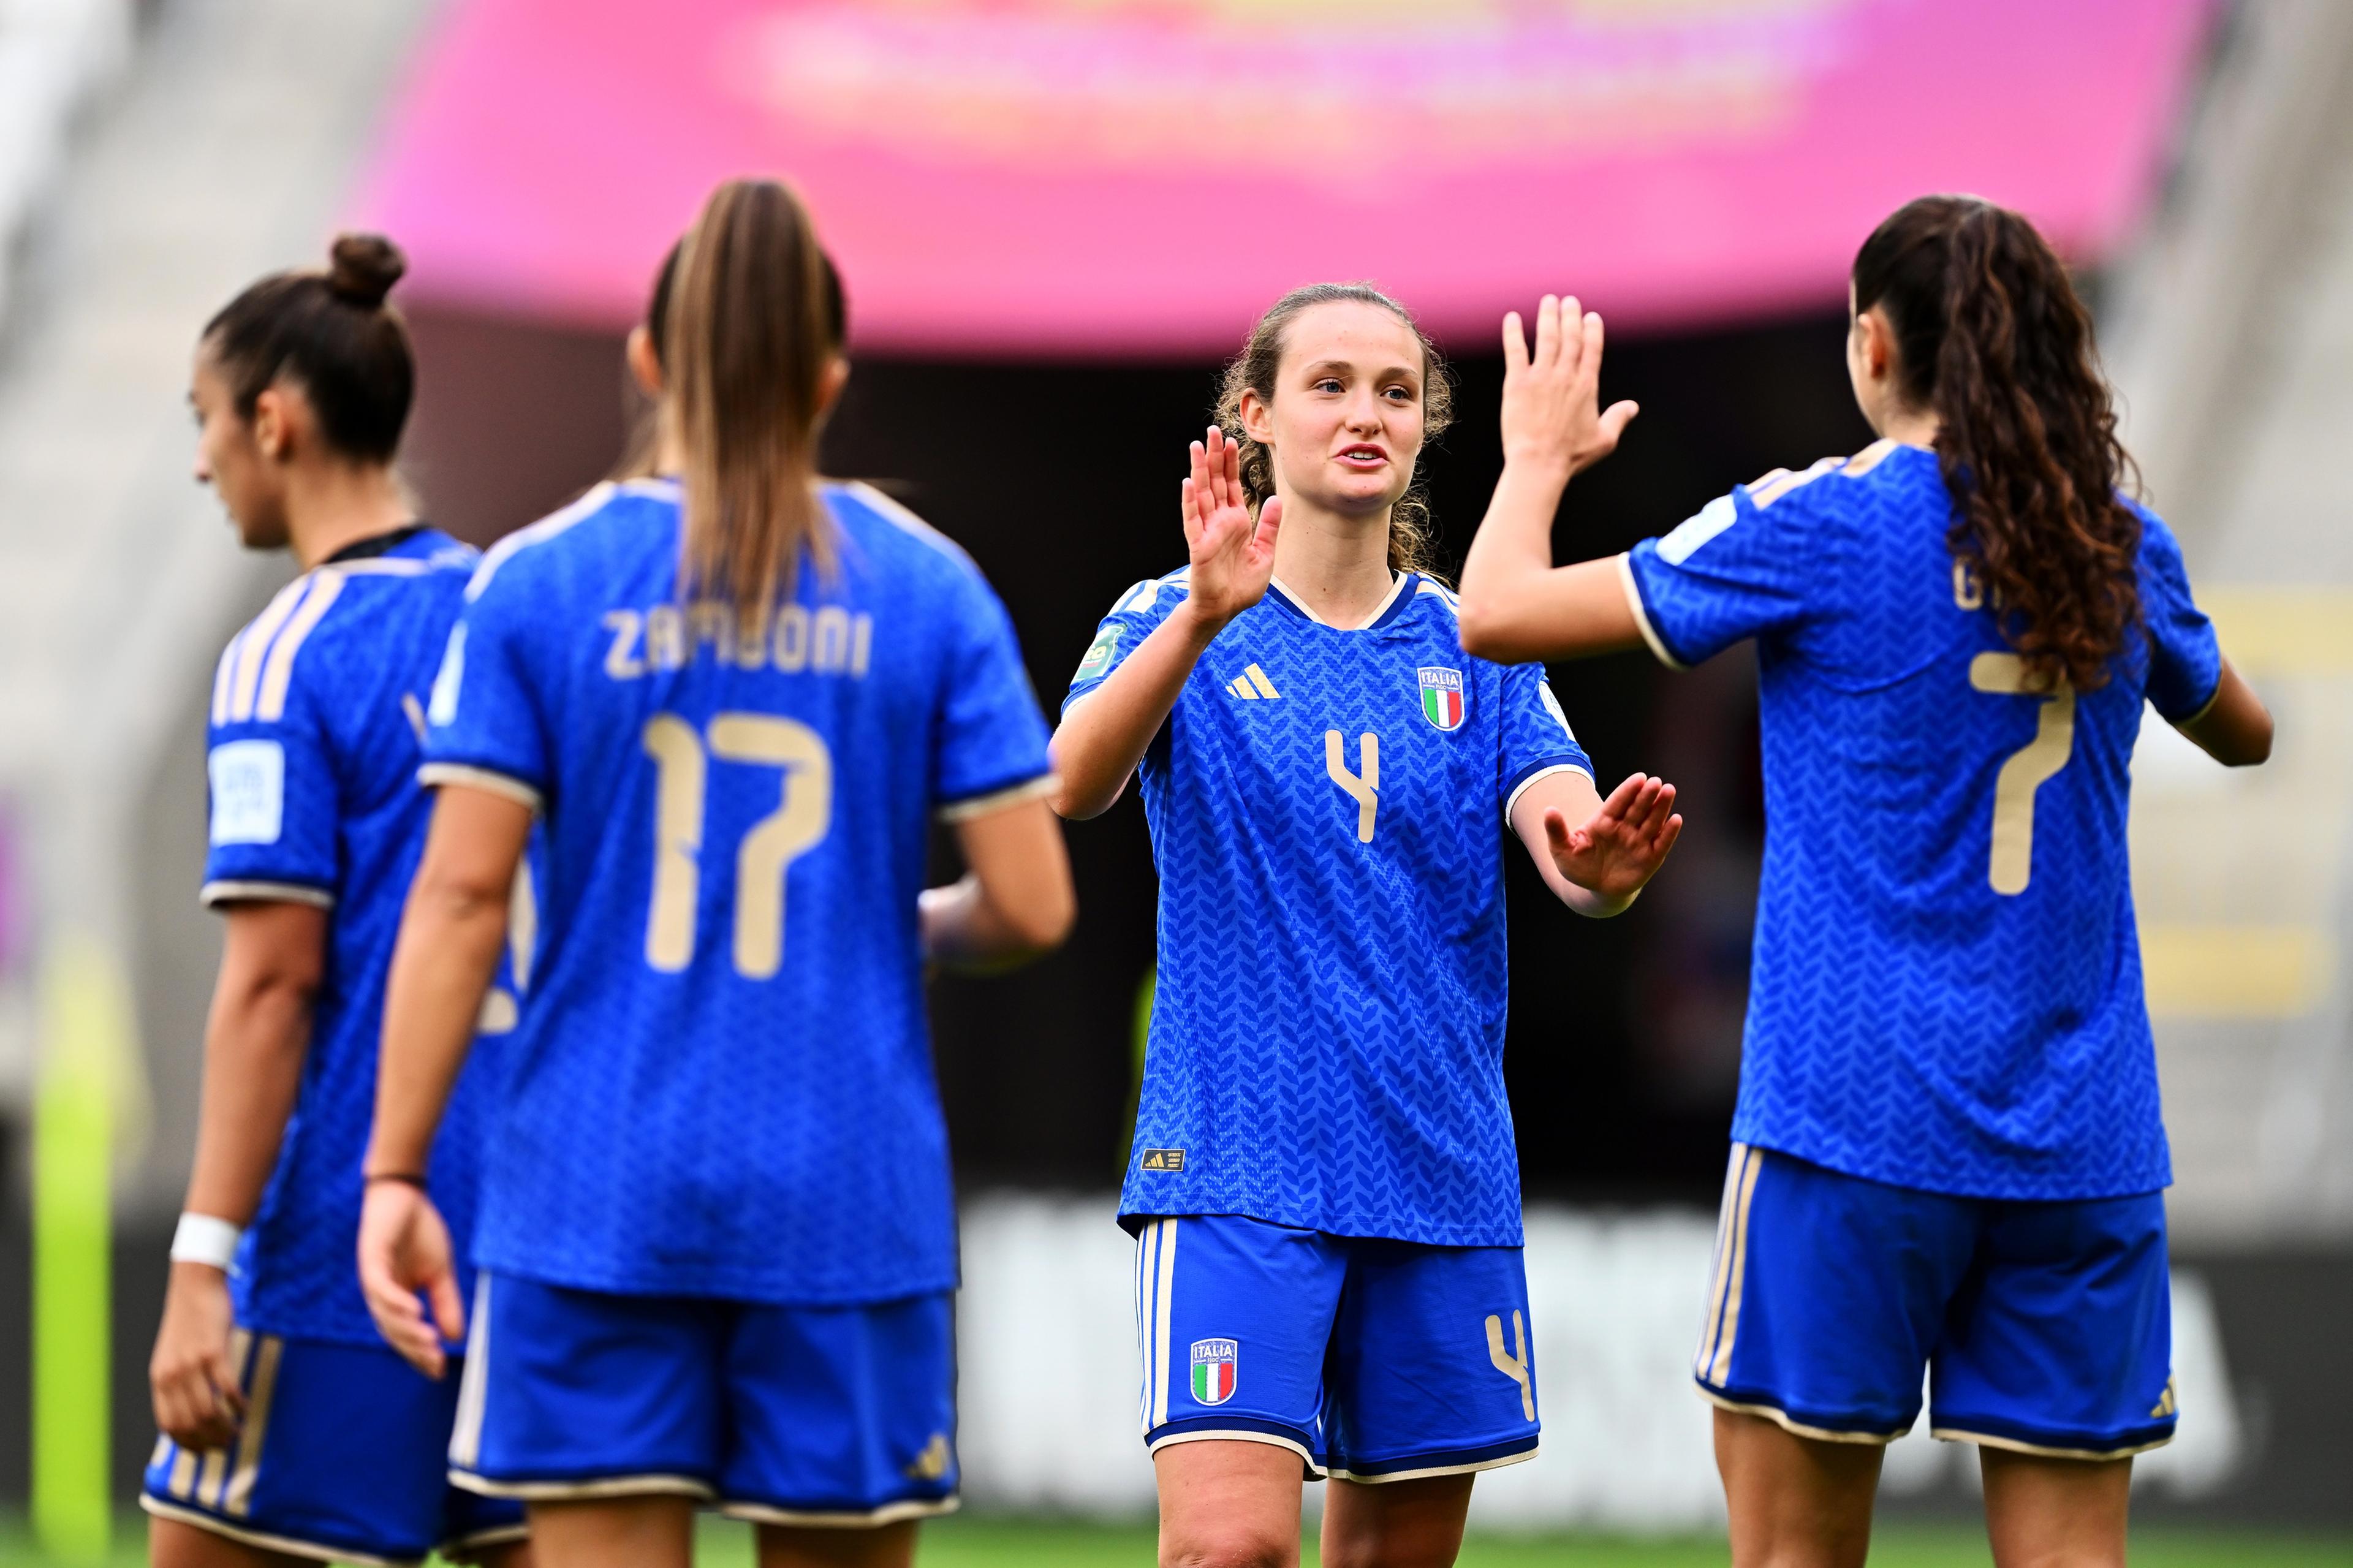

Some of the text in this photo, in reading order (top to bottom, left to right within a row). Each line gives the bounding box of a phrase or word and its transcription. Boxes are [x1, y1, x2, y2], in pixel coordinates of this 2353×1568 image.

[1422, 672, 1458, 686] ITALIA
[1325, 729, 1379, 843] 4
[1969, 651, 2075, 895] 7
[644, 711, 832, 979] 17
[1194, 1344, 1233, 1358] ITALIA
[1485, 1309, 1535, 1422] 4
